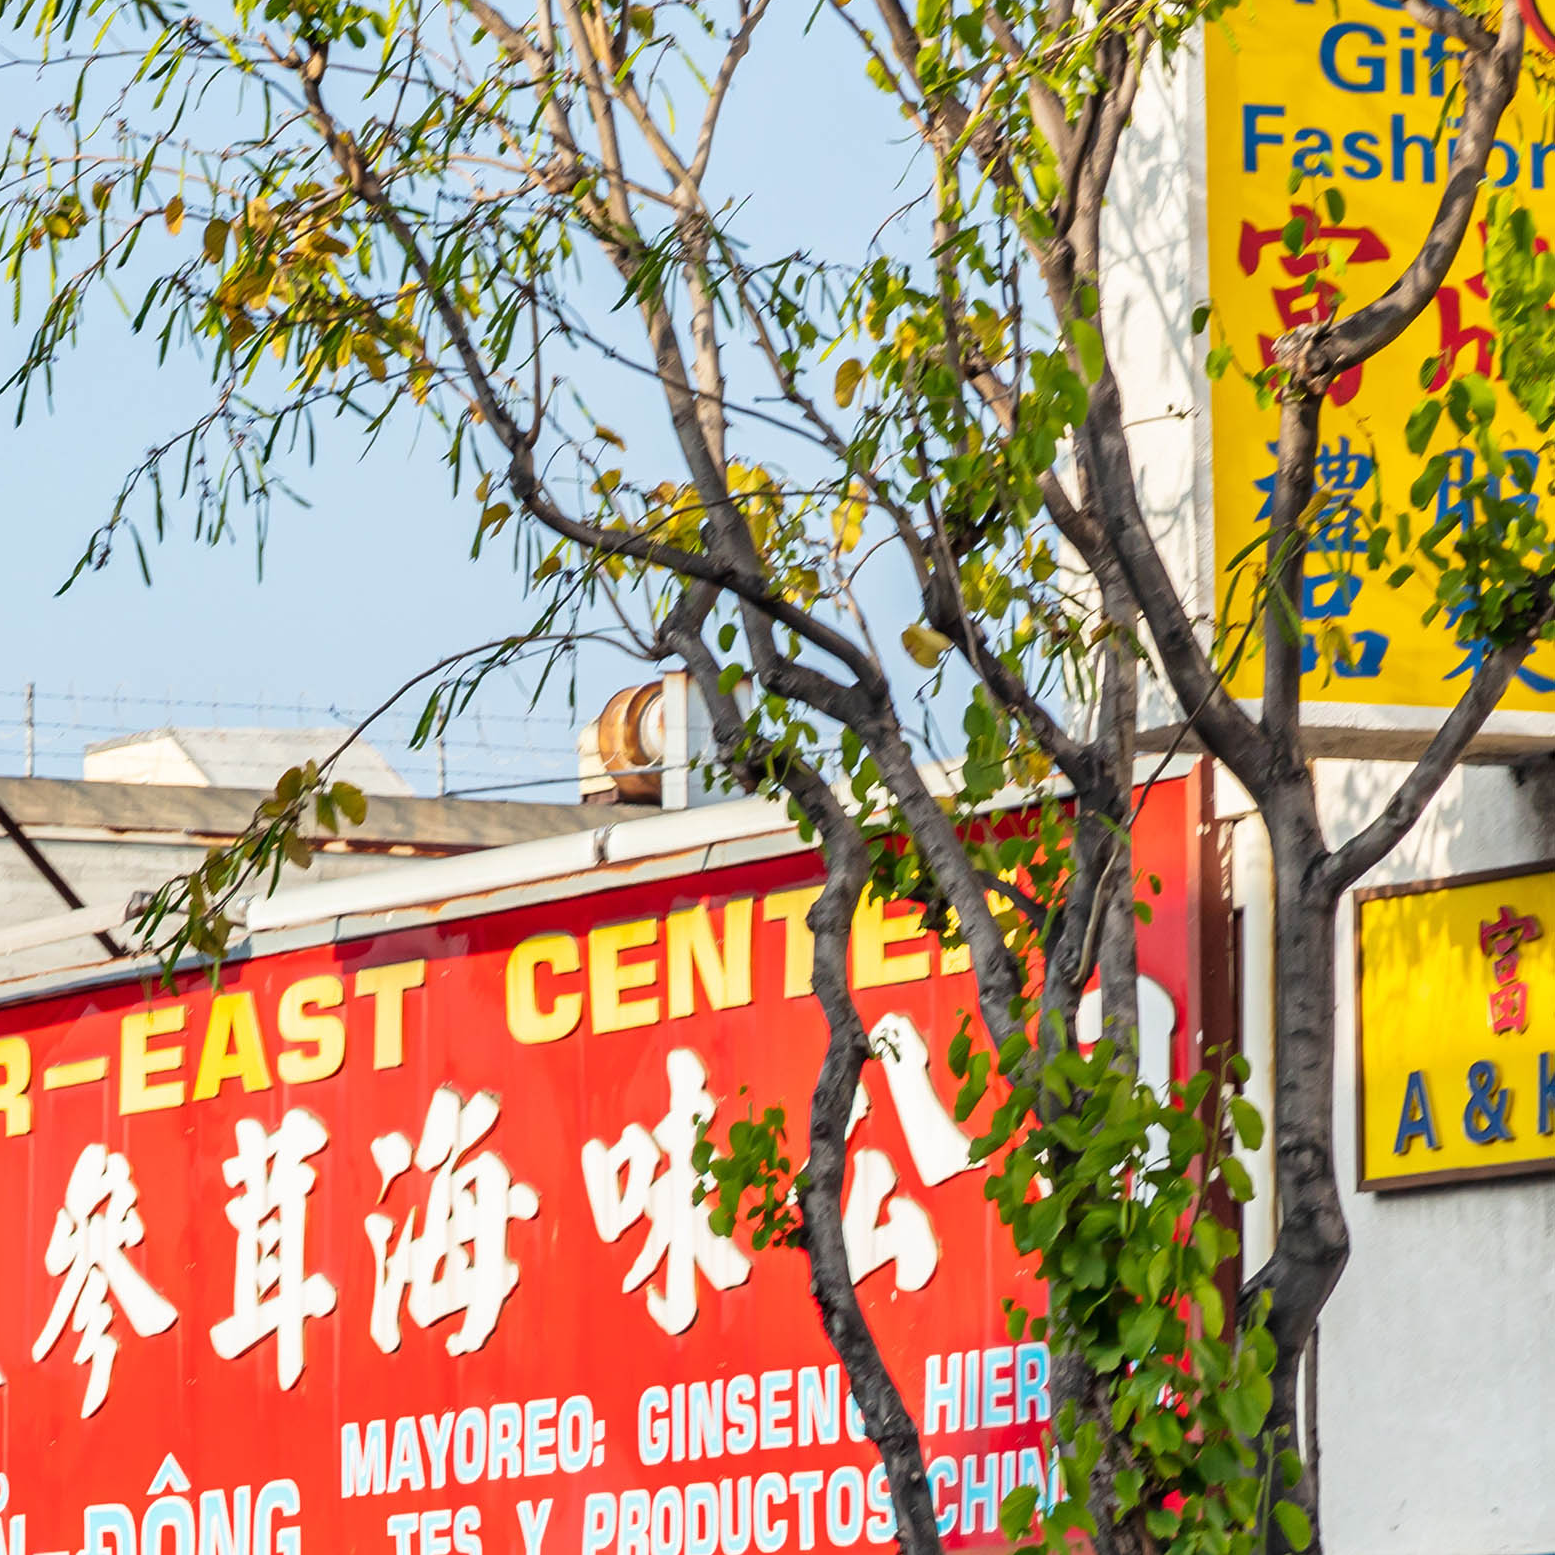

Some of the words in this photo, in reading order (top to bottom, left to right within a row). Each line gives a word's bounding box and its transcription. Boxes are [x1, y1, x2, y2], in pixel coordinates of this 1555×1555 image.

[1319, 22, 1468, 98] Gif
[1393, 1070, 1440, 1155] A
[1463, 1060, 1514, 1145] &
[340, 1393, 606, 1500] MAYOREO:
[924, 1340, 1053, 1436] HIER
